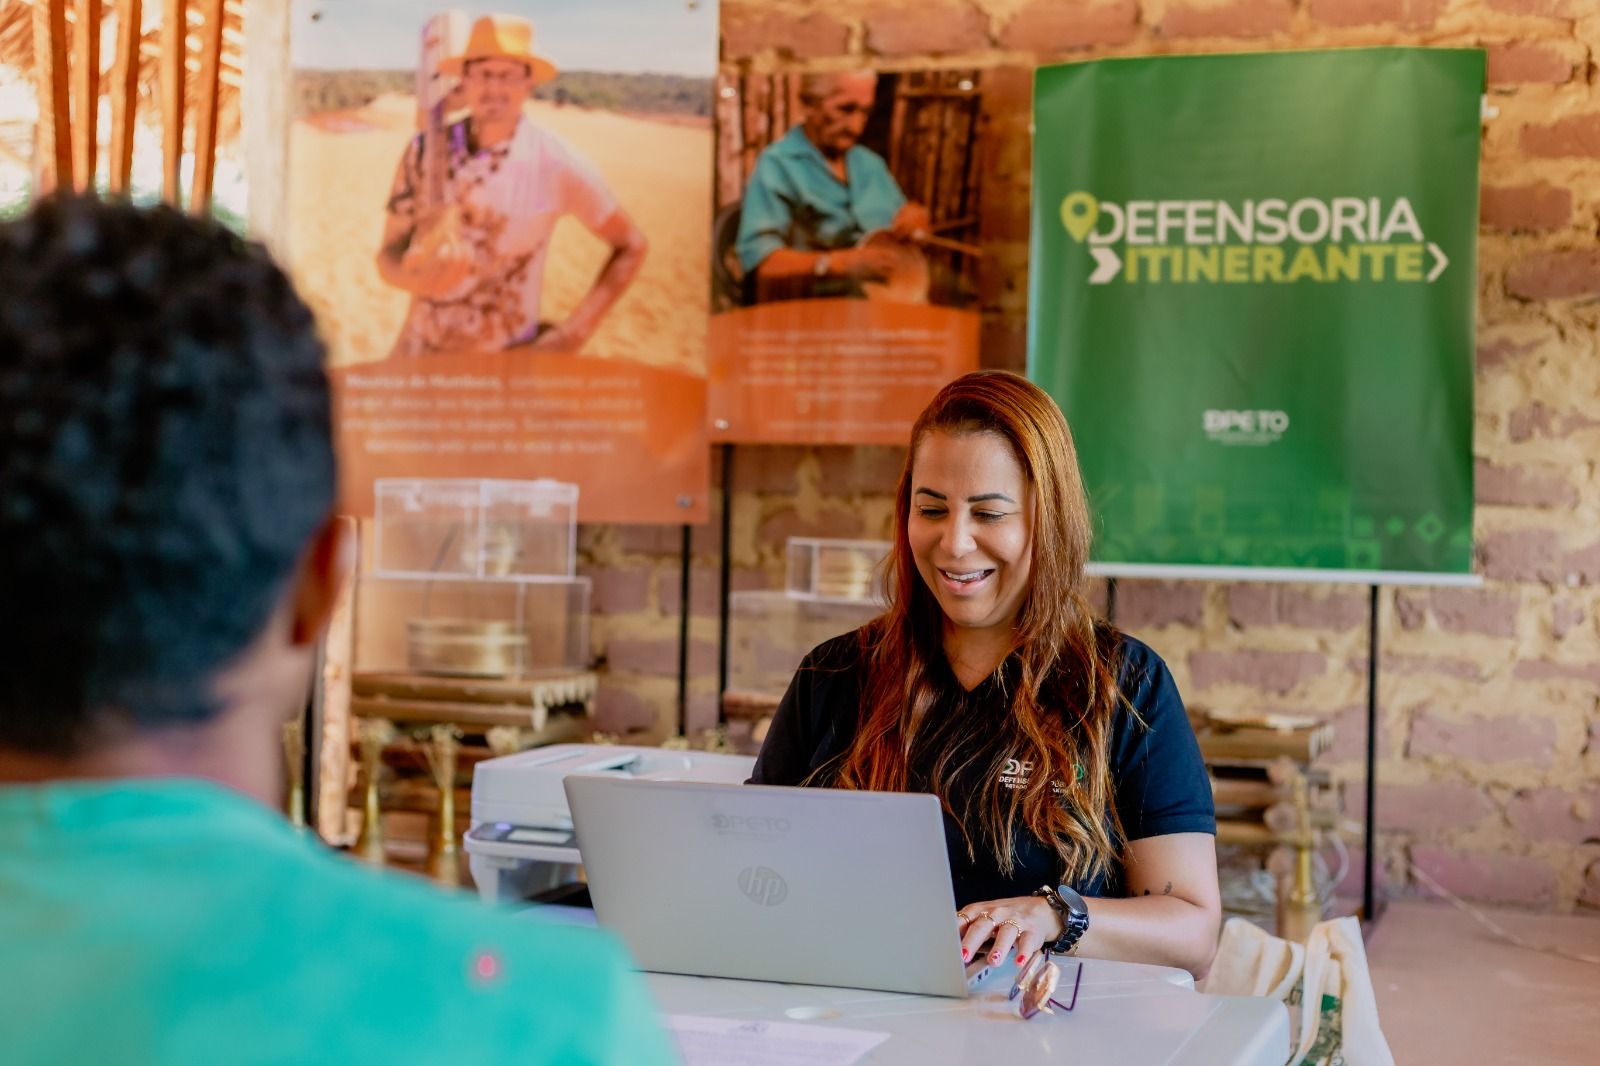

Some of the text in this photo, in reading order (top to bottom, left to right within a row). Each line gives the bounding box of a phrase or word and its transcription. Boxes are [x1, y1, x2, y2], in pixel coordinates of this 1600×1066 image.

[1088, 197, 1424, 245] DEFENSORIA
[1125, 244, 1424, 284] ITINERANTE
[741, 866, 786, 907] hp
